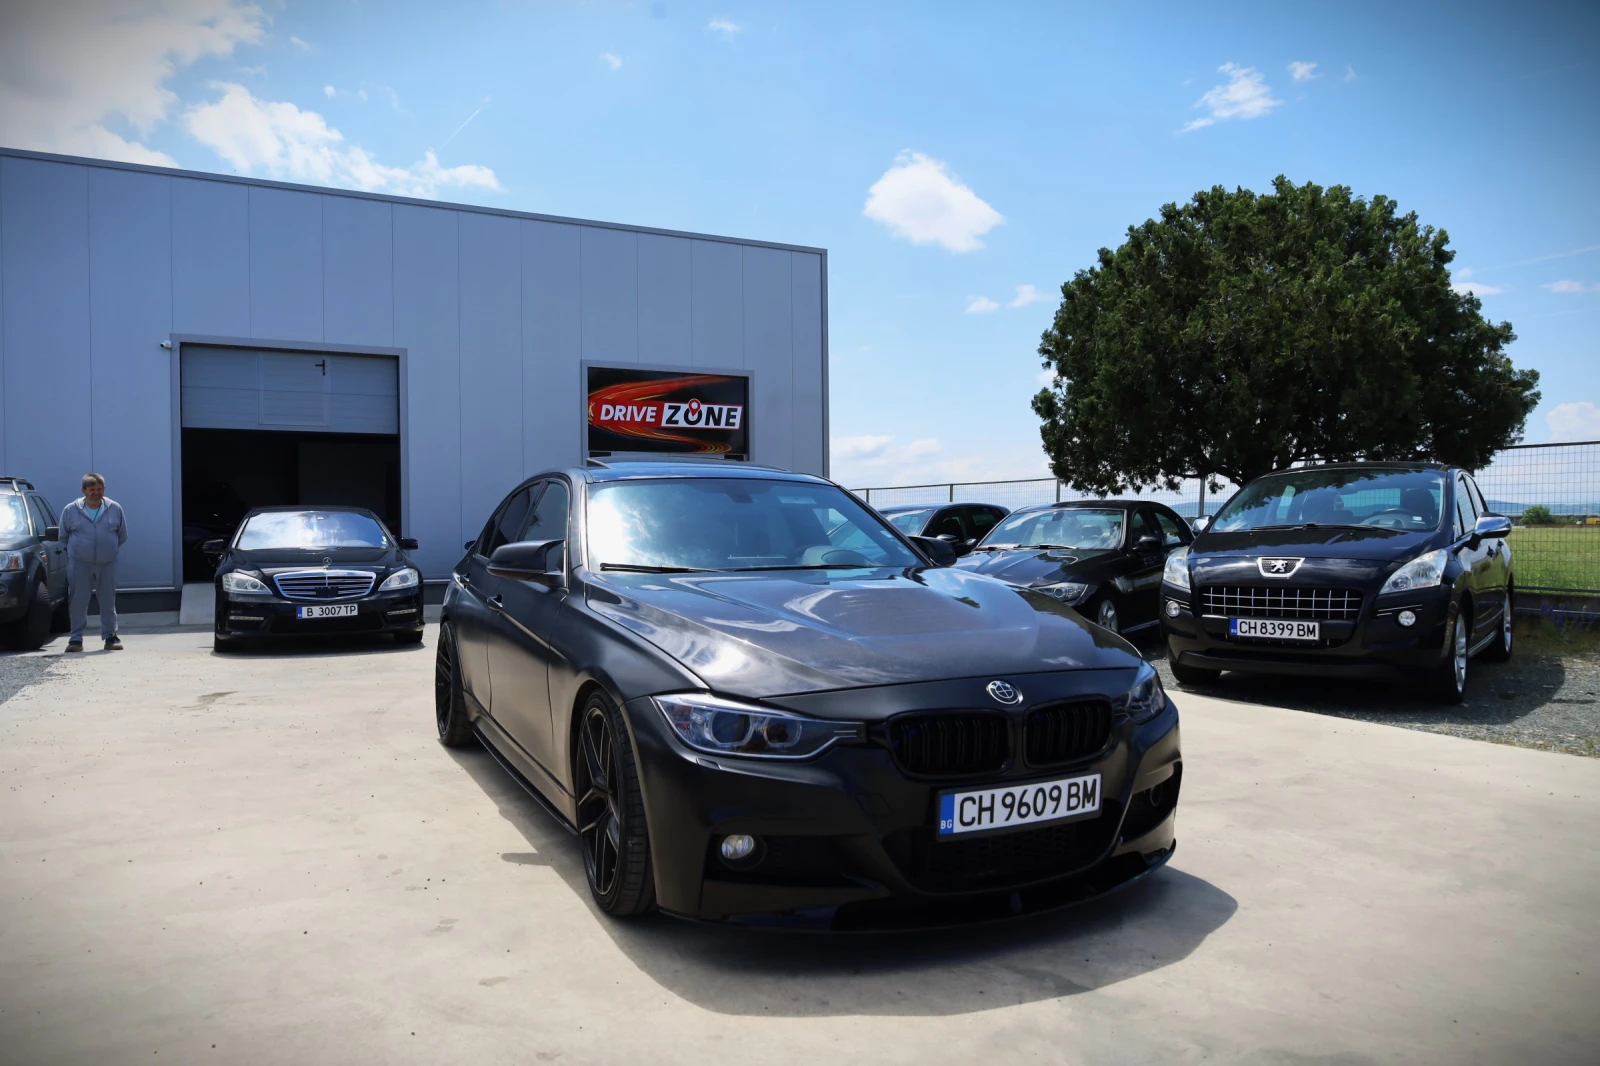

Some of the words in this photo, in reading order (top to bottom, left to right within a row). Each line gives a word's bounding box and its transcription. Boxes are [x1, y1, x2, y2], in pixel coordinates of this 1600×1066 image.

[600, 404, 657, 422] DRIVE
[665, 402, 738, 427] ZONE
[306, 607, 314, 617] B
[318, 606, 342, 617] 3007
[343, 605, 356, 615] TP
[1239, 621, 1257, 634] CH
[1260, 622, 1294, 636] 8399
[1297, 624, 1316, 637] BM
[959, 793, 995, 826] CH
[1001, 785, 1062, 821] 9609
[1067, 778, 1097, 811] BM
[940, 819, 953, 830] BG
